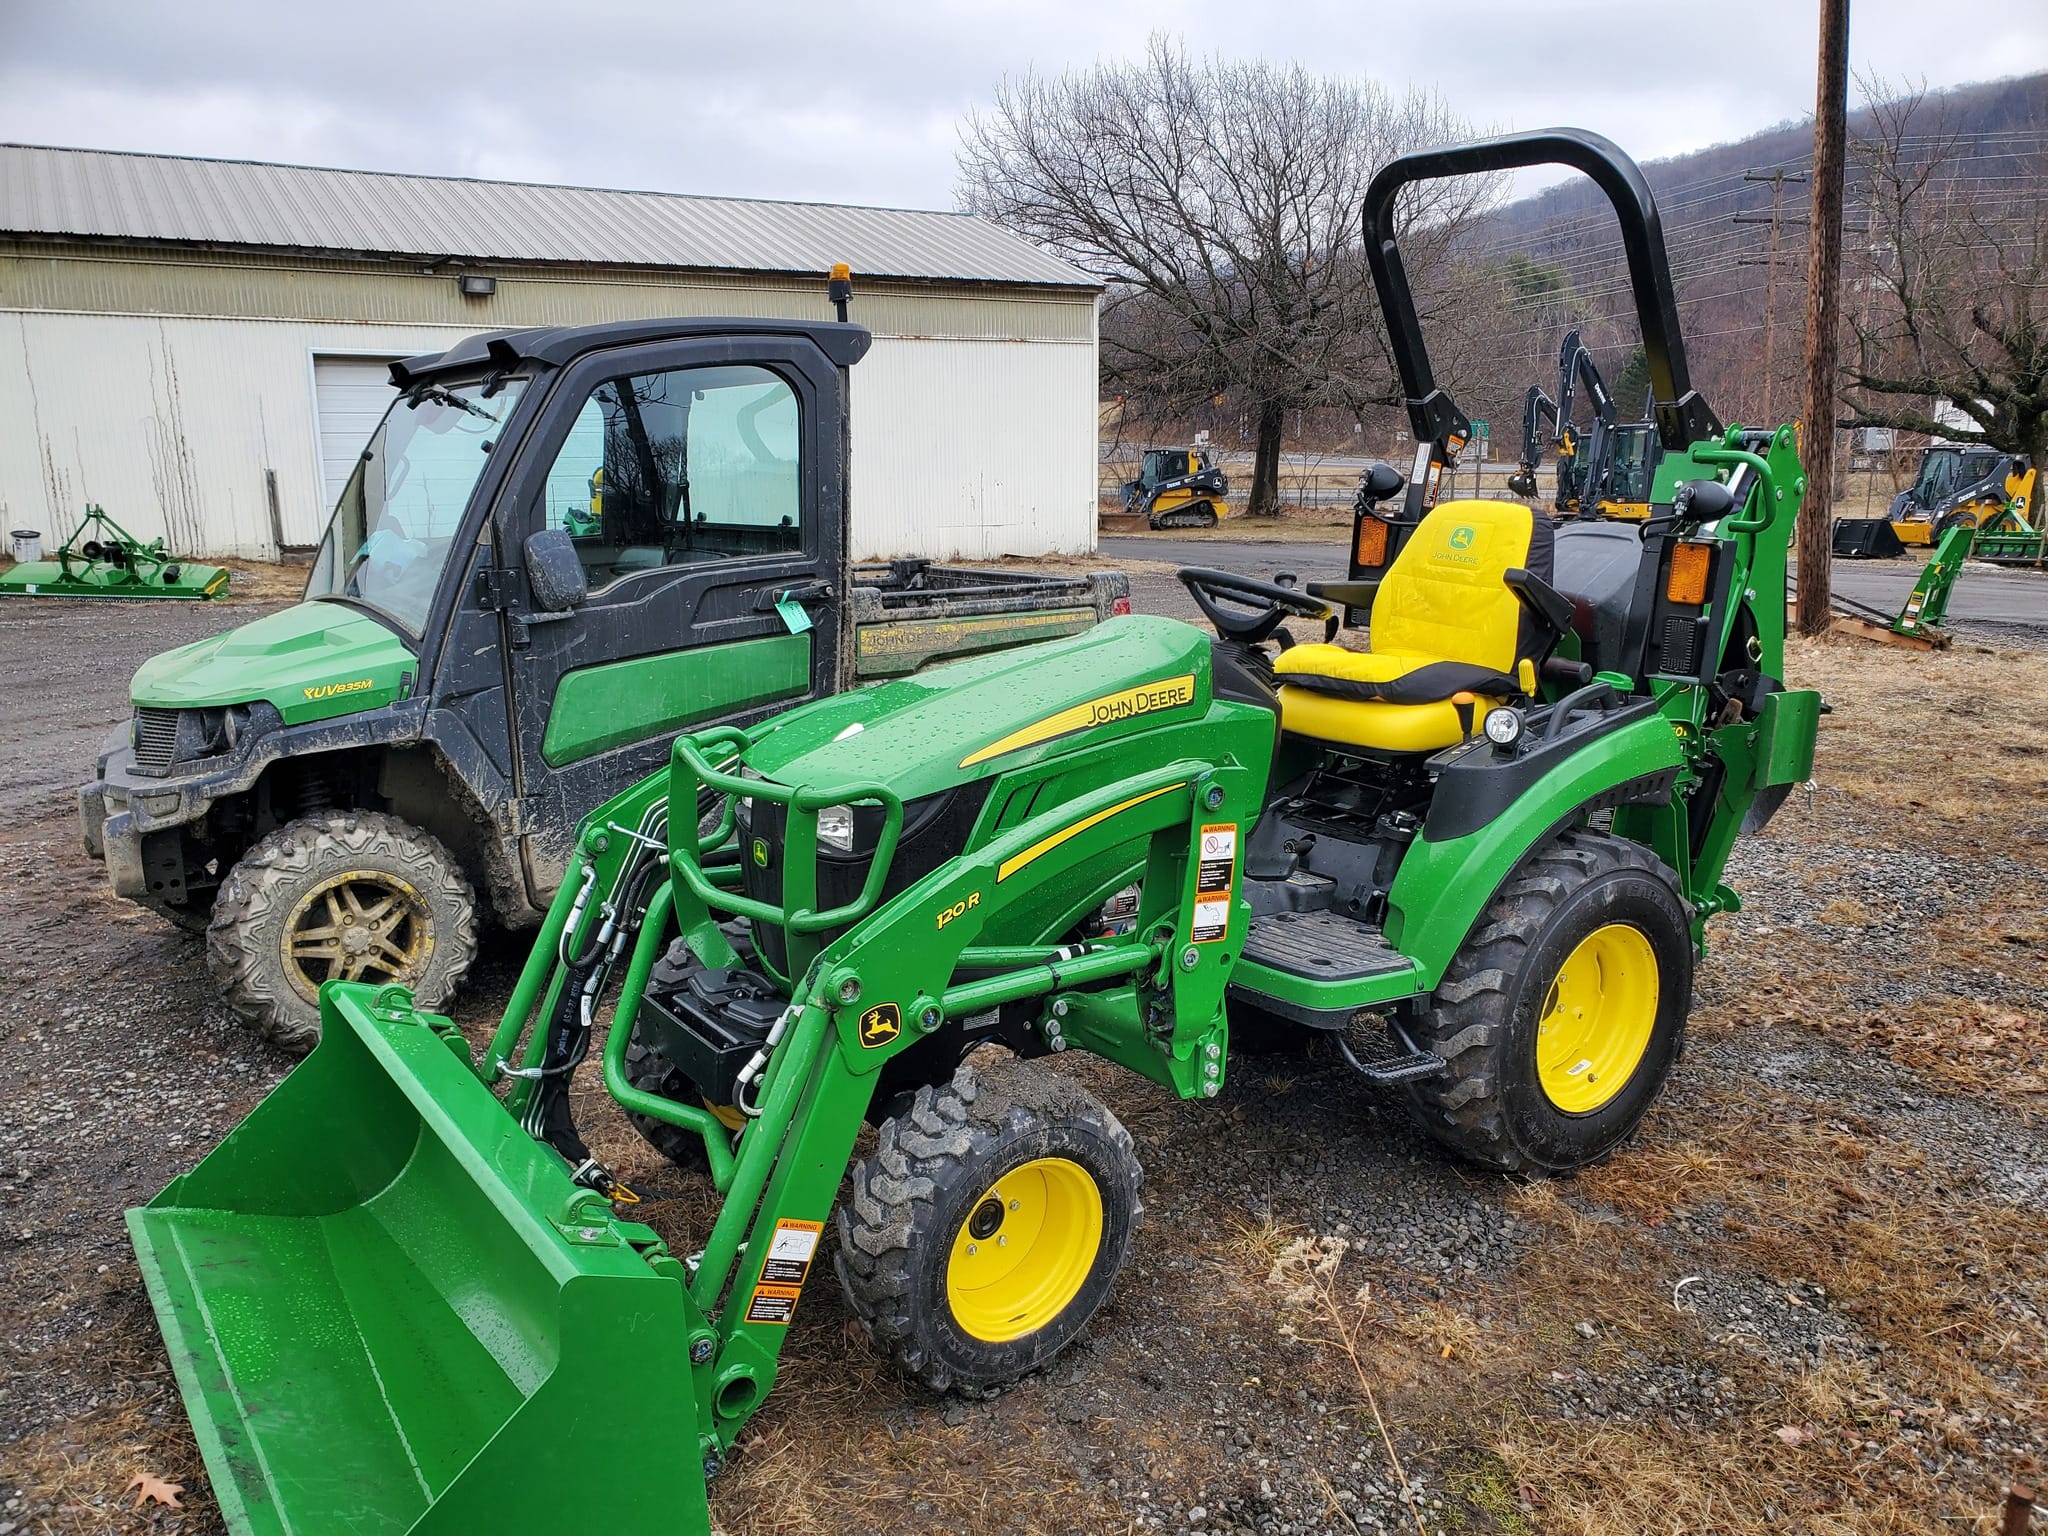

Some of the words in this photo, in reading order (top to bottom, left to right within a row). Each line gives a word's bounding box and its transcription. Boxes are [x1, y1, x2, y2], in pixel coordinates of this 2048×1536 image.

[1432, 551, 1452, 561] JOHN
[1453, 553, 1479, 565] DEERE
[1087, 698, 1134, 725] JOHN
[1135, 686, 1188, 711] DEERE
[1208, 824, 1236, 833] WARNING
[1202, 894, 1229, 903] WARNING
[789, 1223, 817, 1231] WARNING
[767, 1289, 795, 1297] WARNING
